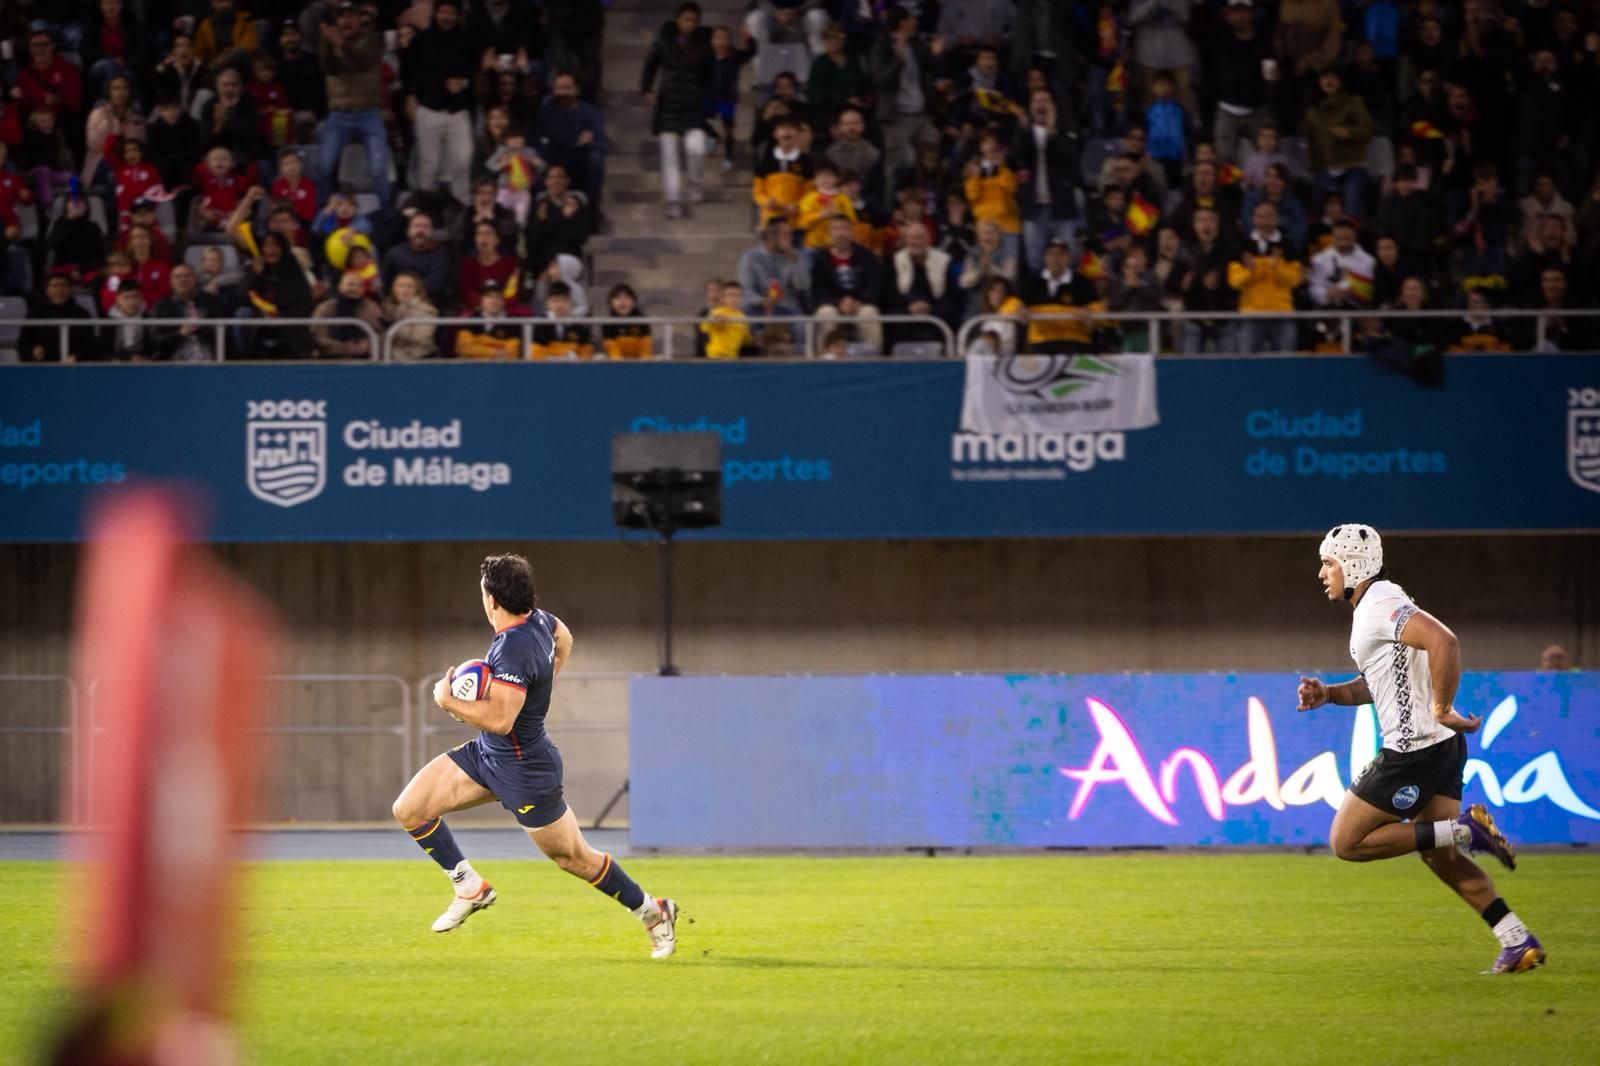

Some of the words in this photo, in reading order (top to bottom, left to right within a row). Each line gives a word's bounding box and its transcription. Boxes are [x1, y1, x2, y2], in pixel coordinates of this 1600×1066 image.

[344, 419, 461, 449] Ciudad
[1245, 409, 1362, 438] Ciudad
[344, 459, 387, 487] de
[394, 457, 511, 492] Málaga
[1245, 449, 1287, 476] de
[1295, 447, 1447, 479] Deportes
[1061, 694, 1600, 826] Andalía
